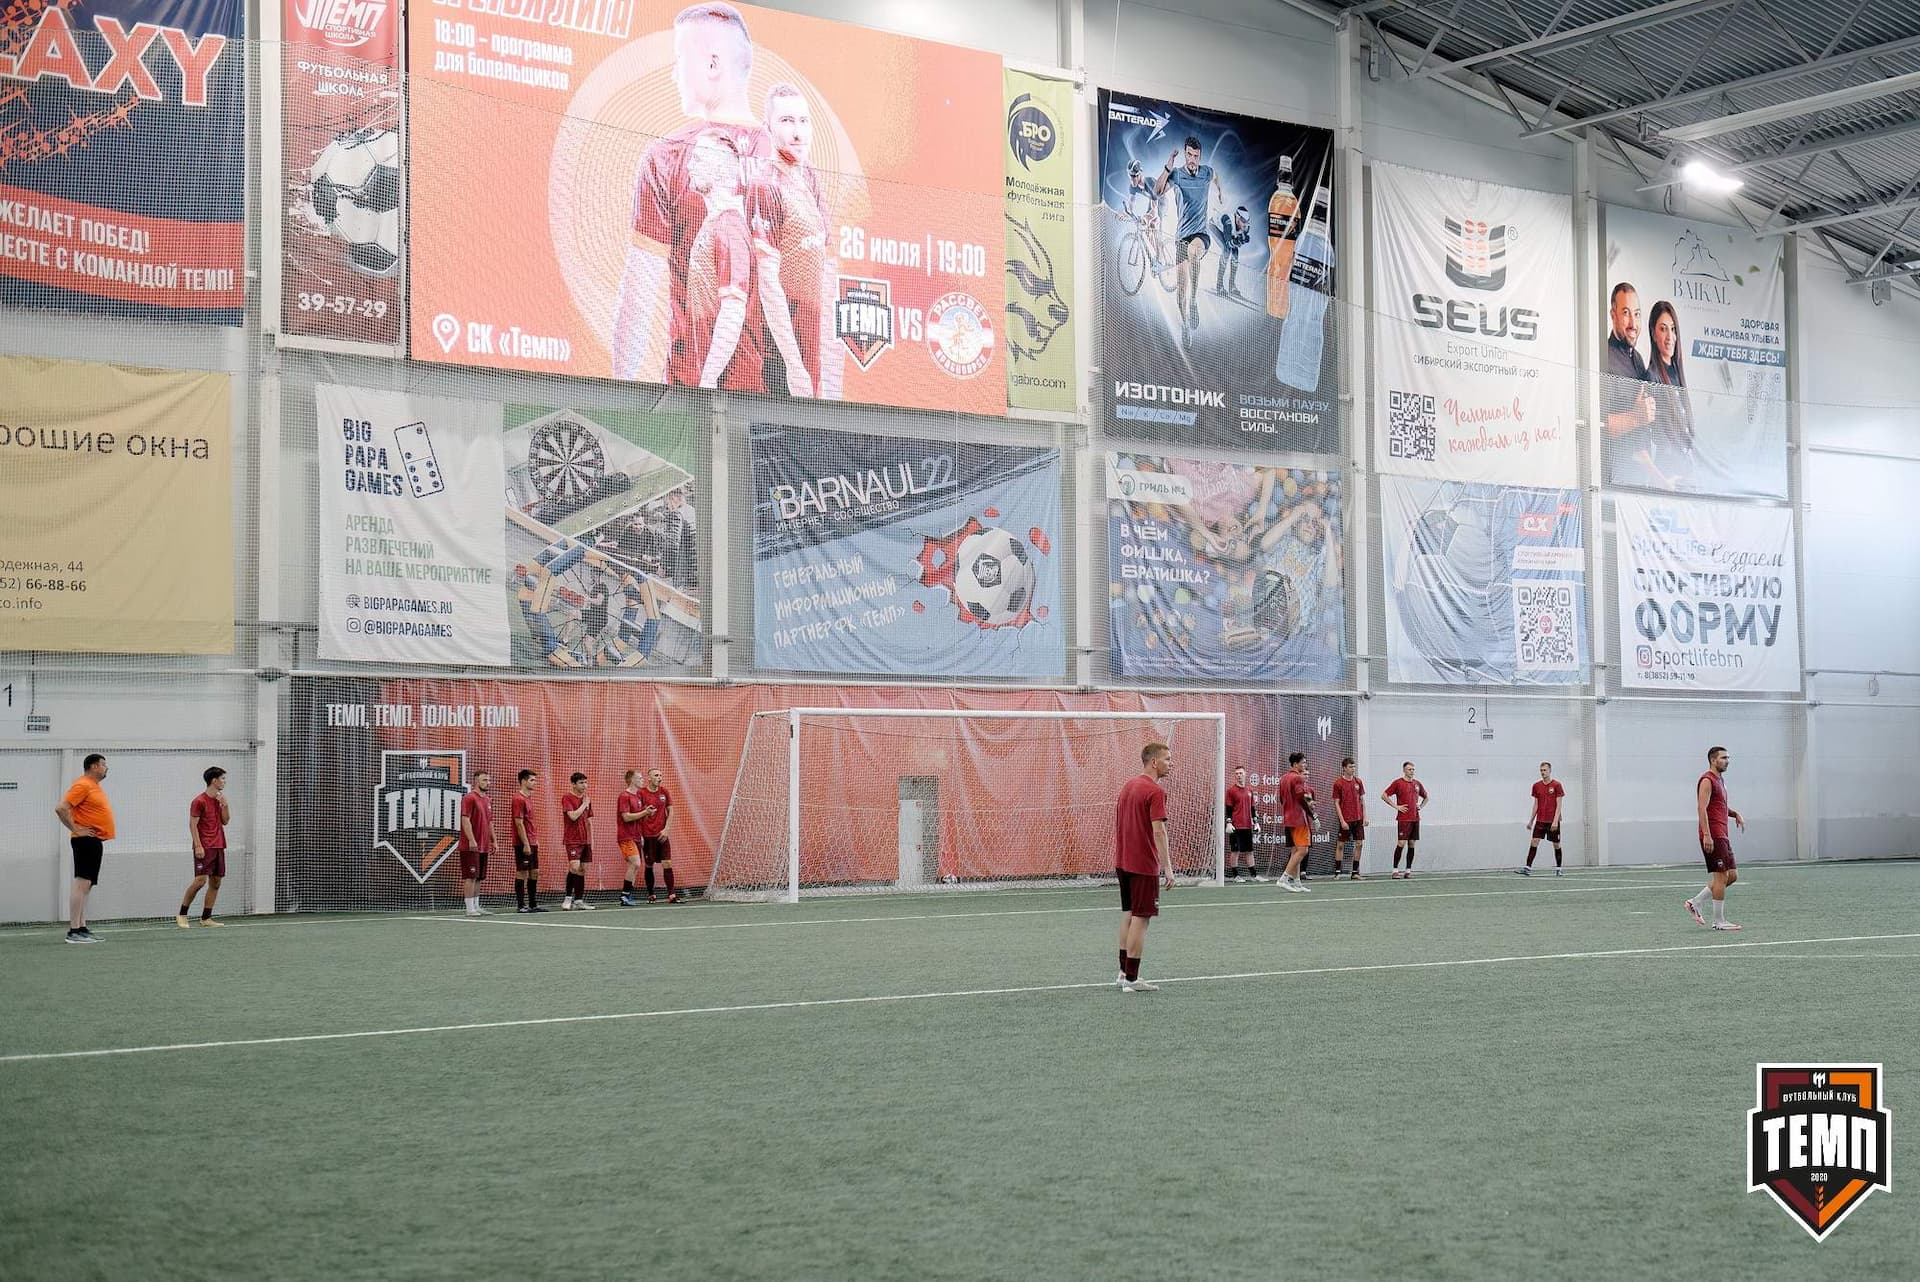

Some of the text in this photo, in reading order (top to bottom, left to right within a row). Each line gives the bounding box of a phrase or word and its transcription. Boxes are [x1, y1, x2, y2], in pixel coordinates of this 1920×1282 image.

[324, 31, 356, 41] ШКОЛА
[434, 18, 475, 48] 18:00
[491, 33, 573, 65] программа
[297, 60, 388, 85] ФУТБОЛЬНАЯ
[434, 50, 570, 90] для болельщиков
[317, 80, 364, 97] ШКОЛА
[1006, 176, 1065, 197] Молодёжная
[1007, 190, 1065, 209] футбольная
[1042, 210, 1065, 222] лига
[80, 219, 150, 253] ПОБЕД!
[839, 226, 986, 277] 26 июля 19:00
[56, 247, 68, 270] С
[73, 252, 178, 289] КОМАНДОЙ
[182, 268, 234, 291] ТЕМП!
[298, 293, 387, 319] 39-57-29
[934, 294, 987, 322] РАССВЕТ
[1412, 293, 1540, 341] SEUS
[838, 302, 923, 342] ТЕМП VS
[1740, 318, 1780, 331] ЗДОРОВАЯ
[467, 322, 571, 362] СК «Темп»
[1703, 327, 1780, 345] И КРАСИВАЯ УЛЫБКА
[1447, 341, 1508, 361] Export Union
[1698, 342, 1780, 363] ЖДЕТ ТЕБЯ ЗДЕСЬ!
[1464, 361, 1518, 376] ЭКСПОРТНЫЙ
[1115, 381, 1226, 408] ИЗОТОНИК
[1239, 394, 1332, 412] ВОЗЬМИ ПАУЗУ.
[1240, 408, 1319, 424] ВОССТАНОВИ
[1241, 421, 1279, 434] СИЛЫ.
[343, 418, 372, 442] BIG
[126, 434, 209, 459] окна
[345, 444, 389, 470] PAPA
[345, 469, 403, 496] GAMES
[1140, 482, 1170, 494] ГРИЛЬ
[346, 514, 394, 534] АРЕНДА
[1120, 519, 1169, 541] В ЧЁМ
[346, 536, 434, 559] РАЗВЛЕЧЕНИЙ
[1120, 544, 1187, 566] ФИШКА,
[67, 561, 84, 573] 44
[345, 558, 491, 585] НА ВАШЕ МЕРОПРИЯТИЕ
[773, 551, 865, 589] ГЕНЕРАЛЬНЫЙ
[1121, 564, 1211, 584] БРАТИШКА?
[25, 578, 88, 592] 66-88-66
[1633, 568, 1783, 600] СПОРТИВНУЮ
[0, 597, 43, 610] o.info
[363, 596, 453, 615] BIGPAPAGAMES.RU
[774, 573, 896, 621] ИНФОРМАЦИОННЫЙ
[364, 619, 453, 638] @BIGPAPAGAMES
[773, 619, 832, 649] ПАРТНЕР
[834, 614, 857, 634] ФК
[1635, 598, 1782, 647] ФОРМУ
[1654, 648, 1744, 670] sportlifebrn
[3, 683, 12, 708] 1
[326, 704, 519, 729] ТЕМП, ТЕМП, ТОЛЬКО ТЕМП!
[1468, 707, 1476, 724] 2
[384, 788, 463, 834] ТЕМП
